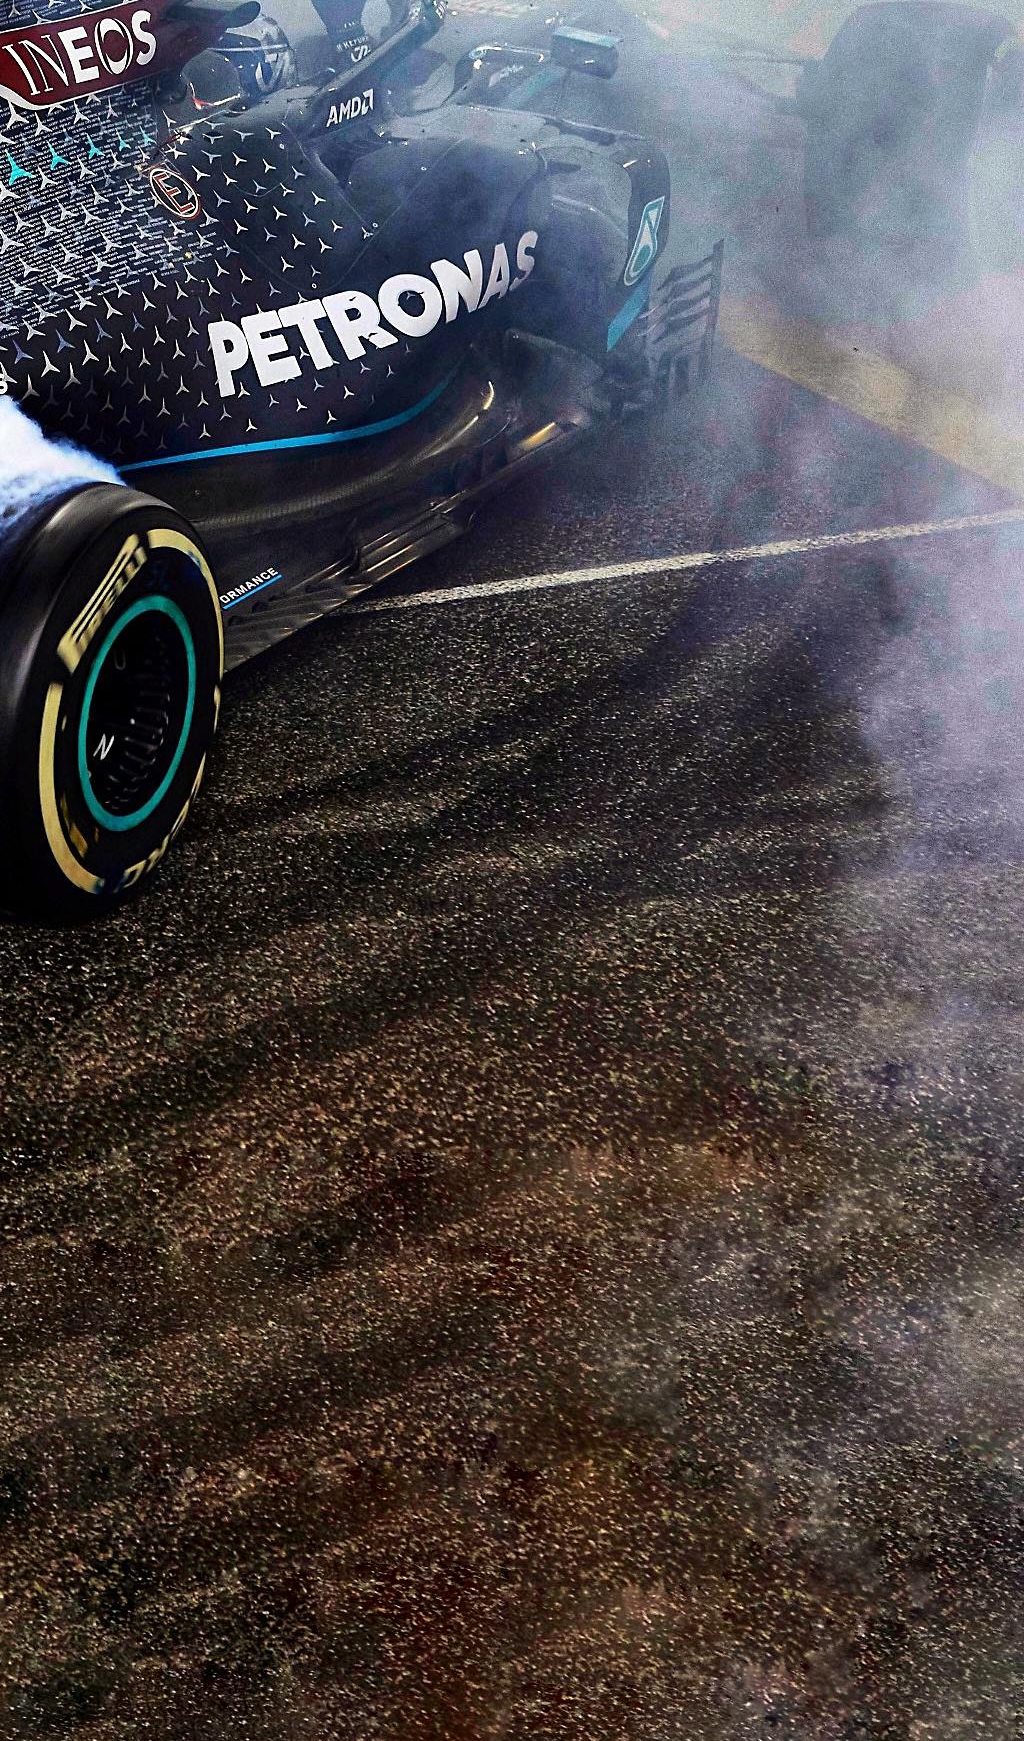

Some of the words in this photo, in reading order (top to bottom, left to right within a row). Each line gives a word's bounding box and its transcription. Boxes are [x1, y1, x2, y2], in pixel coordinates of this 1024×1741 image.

[2, 10, 157, 95] INEOS
[326, 96, 362, 128] AMD
[207, 230, 539, 398] PETRONAS
